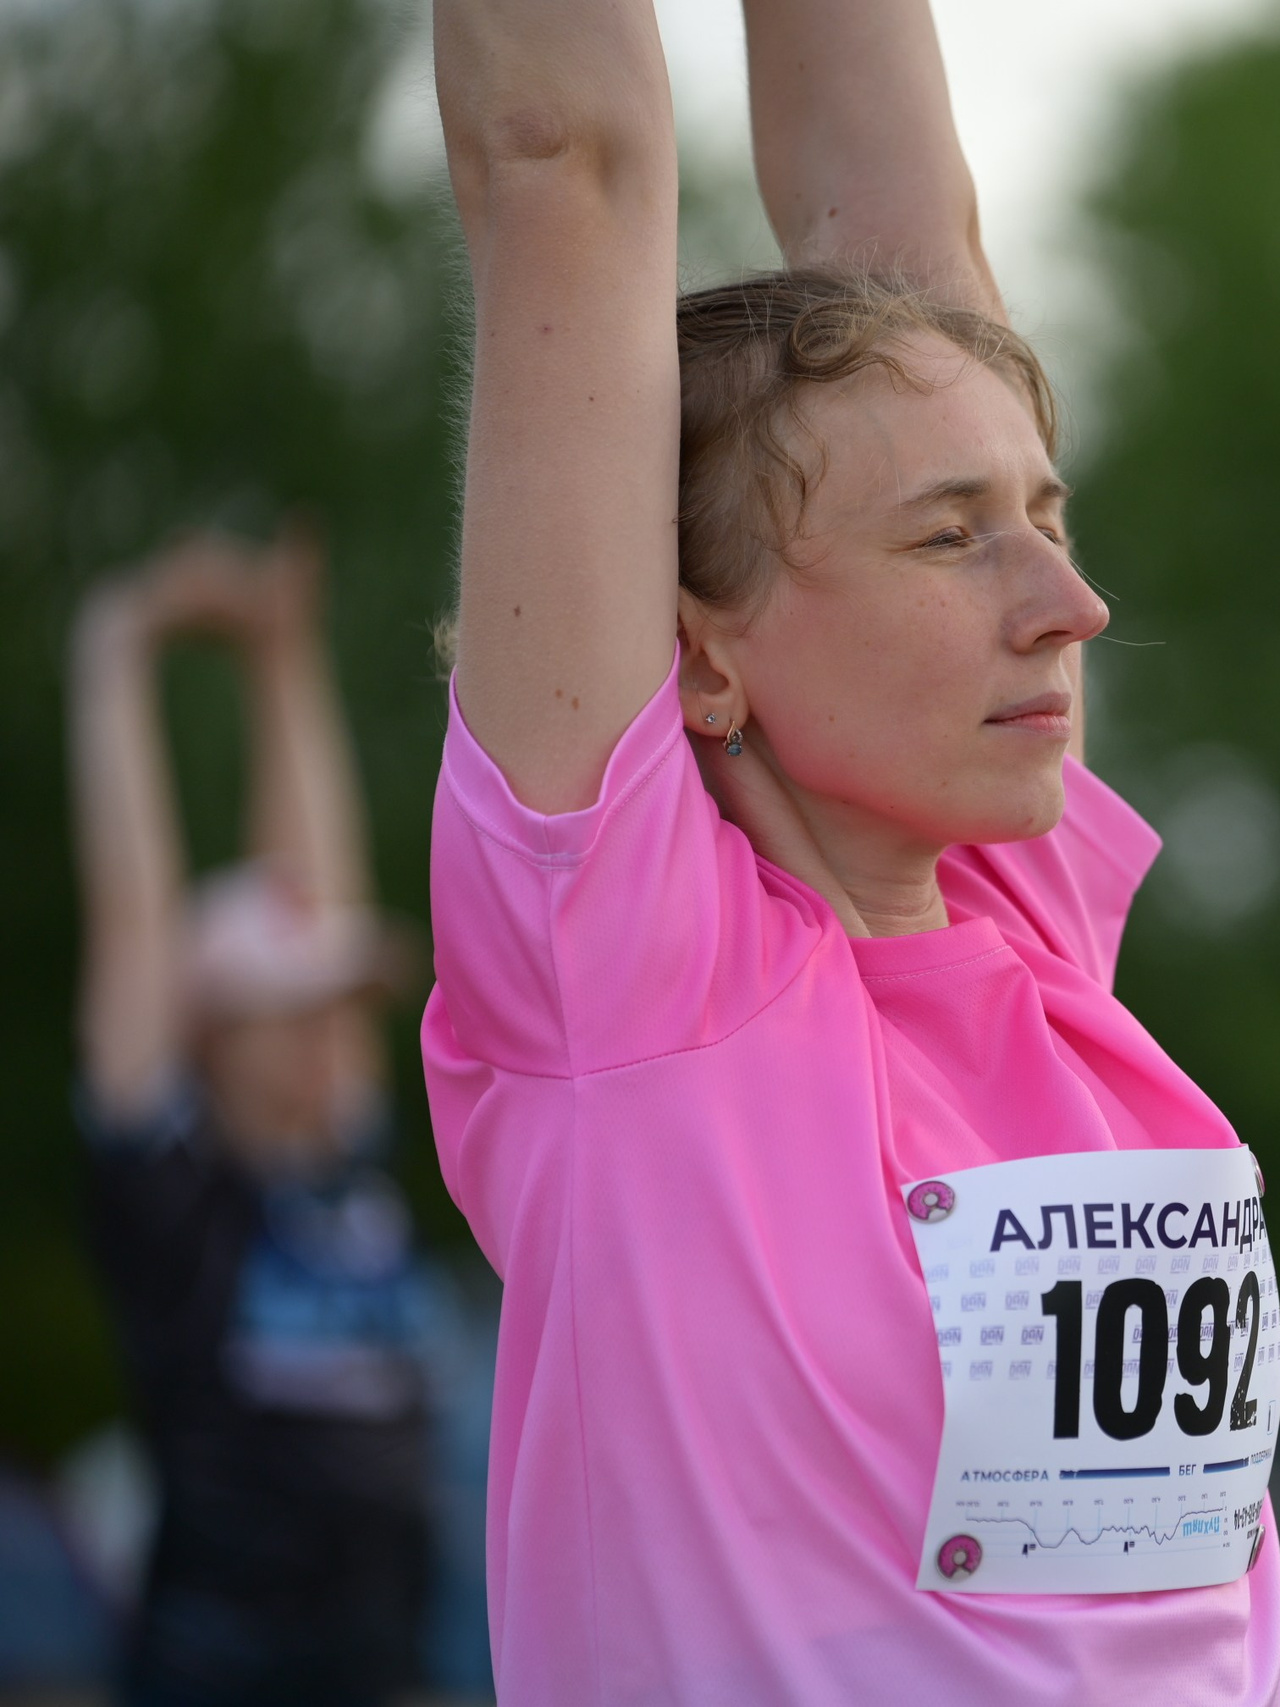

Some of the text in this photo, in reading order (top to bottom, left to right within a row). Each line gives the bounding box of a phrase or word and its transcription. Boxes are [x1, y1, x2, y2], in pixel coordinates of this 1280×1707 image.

[1041, 1271, 1260, 1442] 1092
[960, 1469, 1049, 1482] АТМОСФЕРА
[1178, 1464, 1197, 1476] БЕГ
